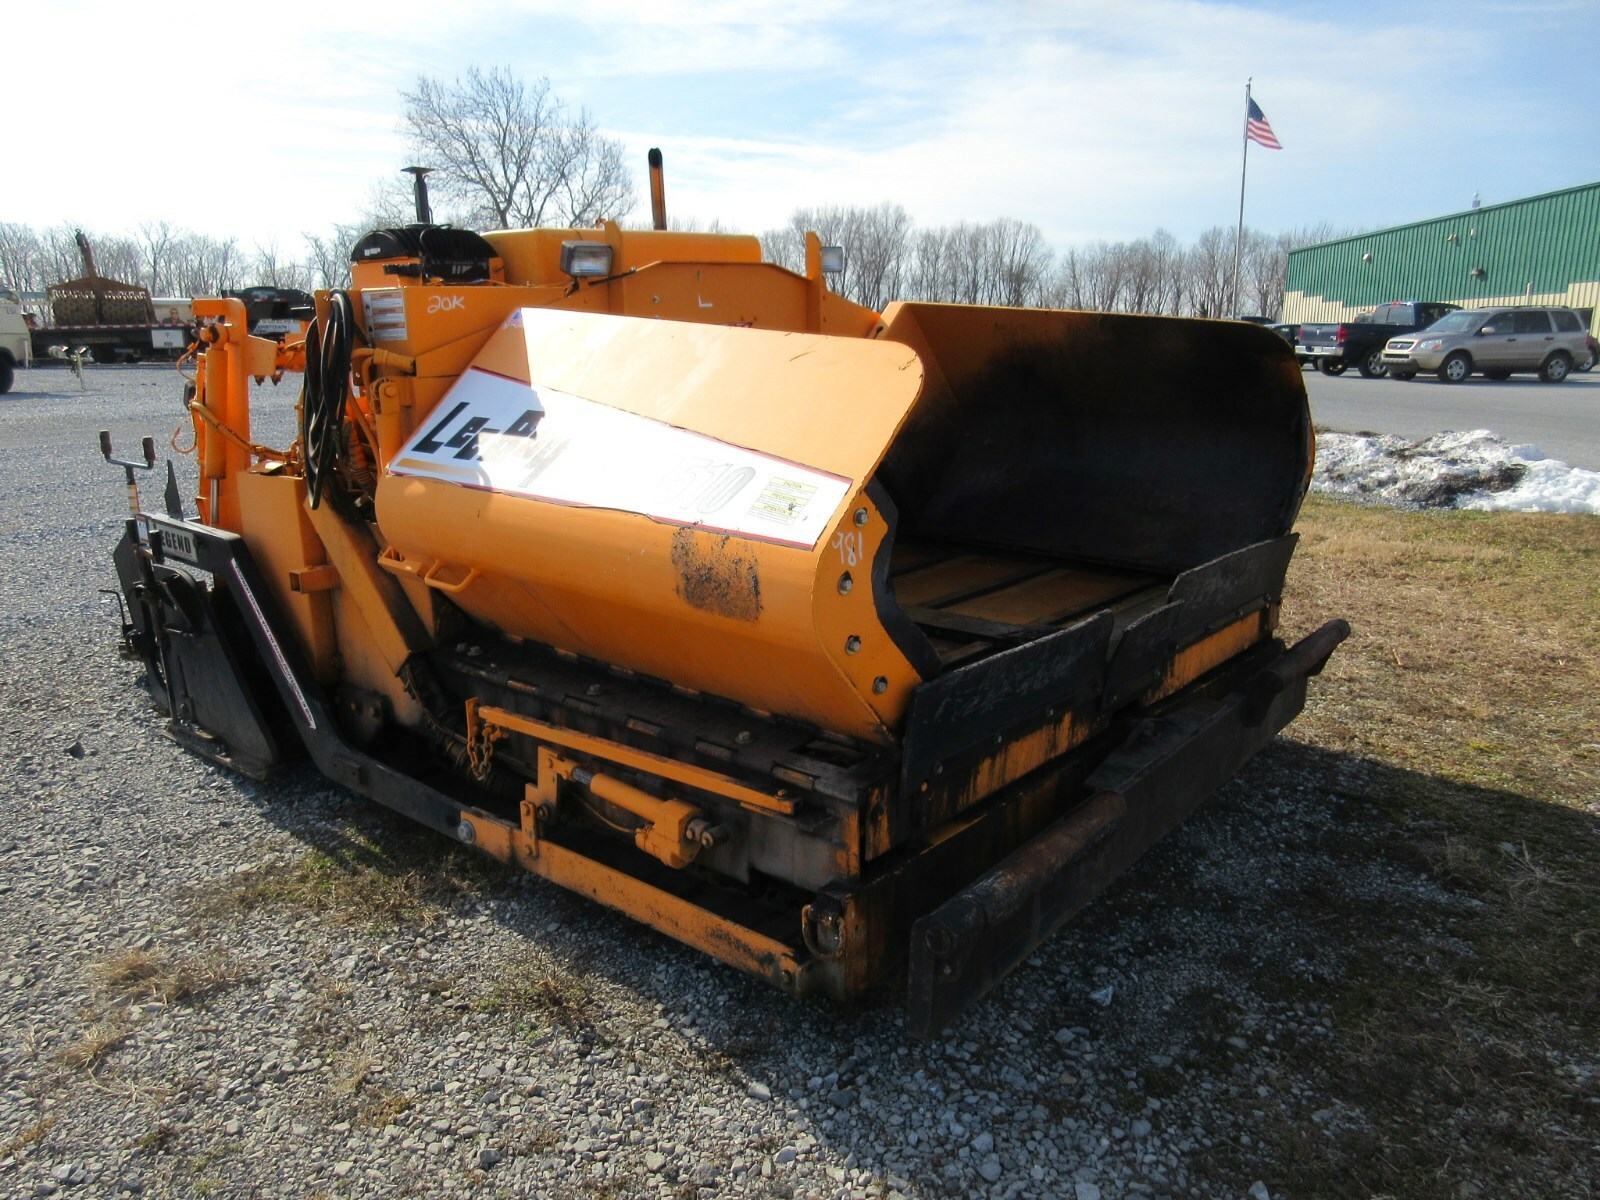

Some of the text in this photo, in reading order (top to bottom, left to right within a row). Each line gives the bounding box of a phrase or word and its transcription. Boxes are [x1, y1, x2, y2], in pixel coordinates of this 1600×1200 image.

[427, 295, 465, 314] 20K
[153, 523, 192, 554] EGEND
[831, 531, 863, 567] 981
